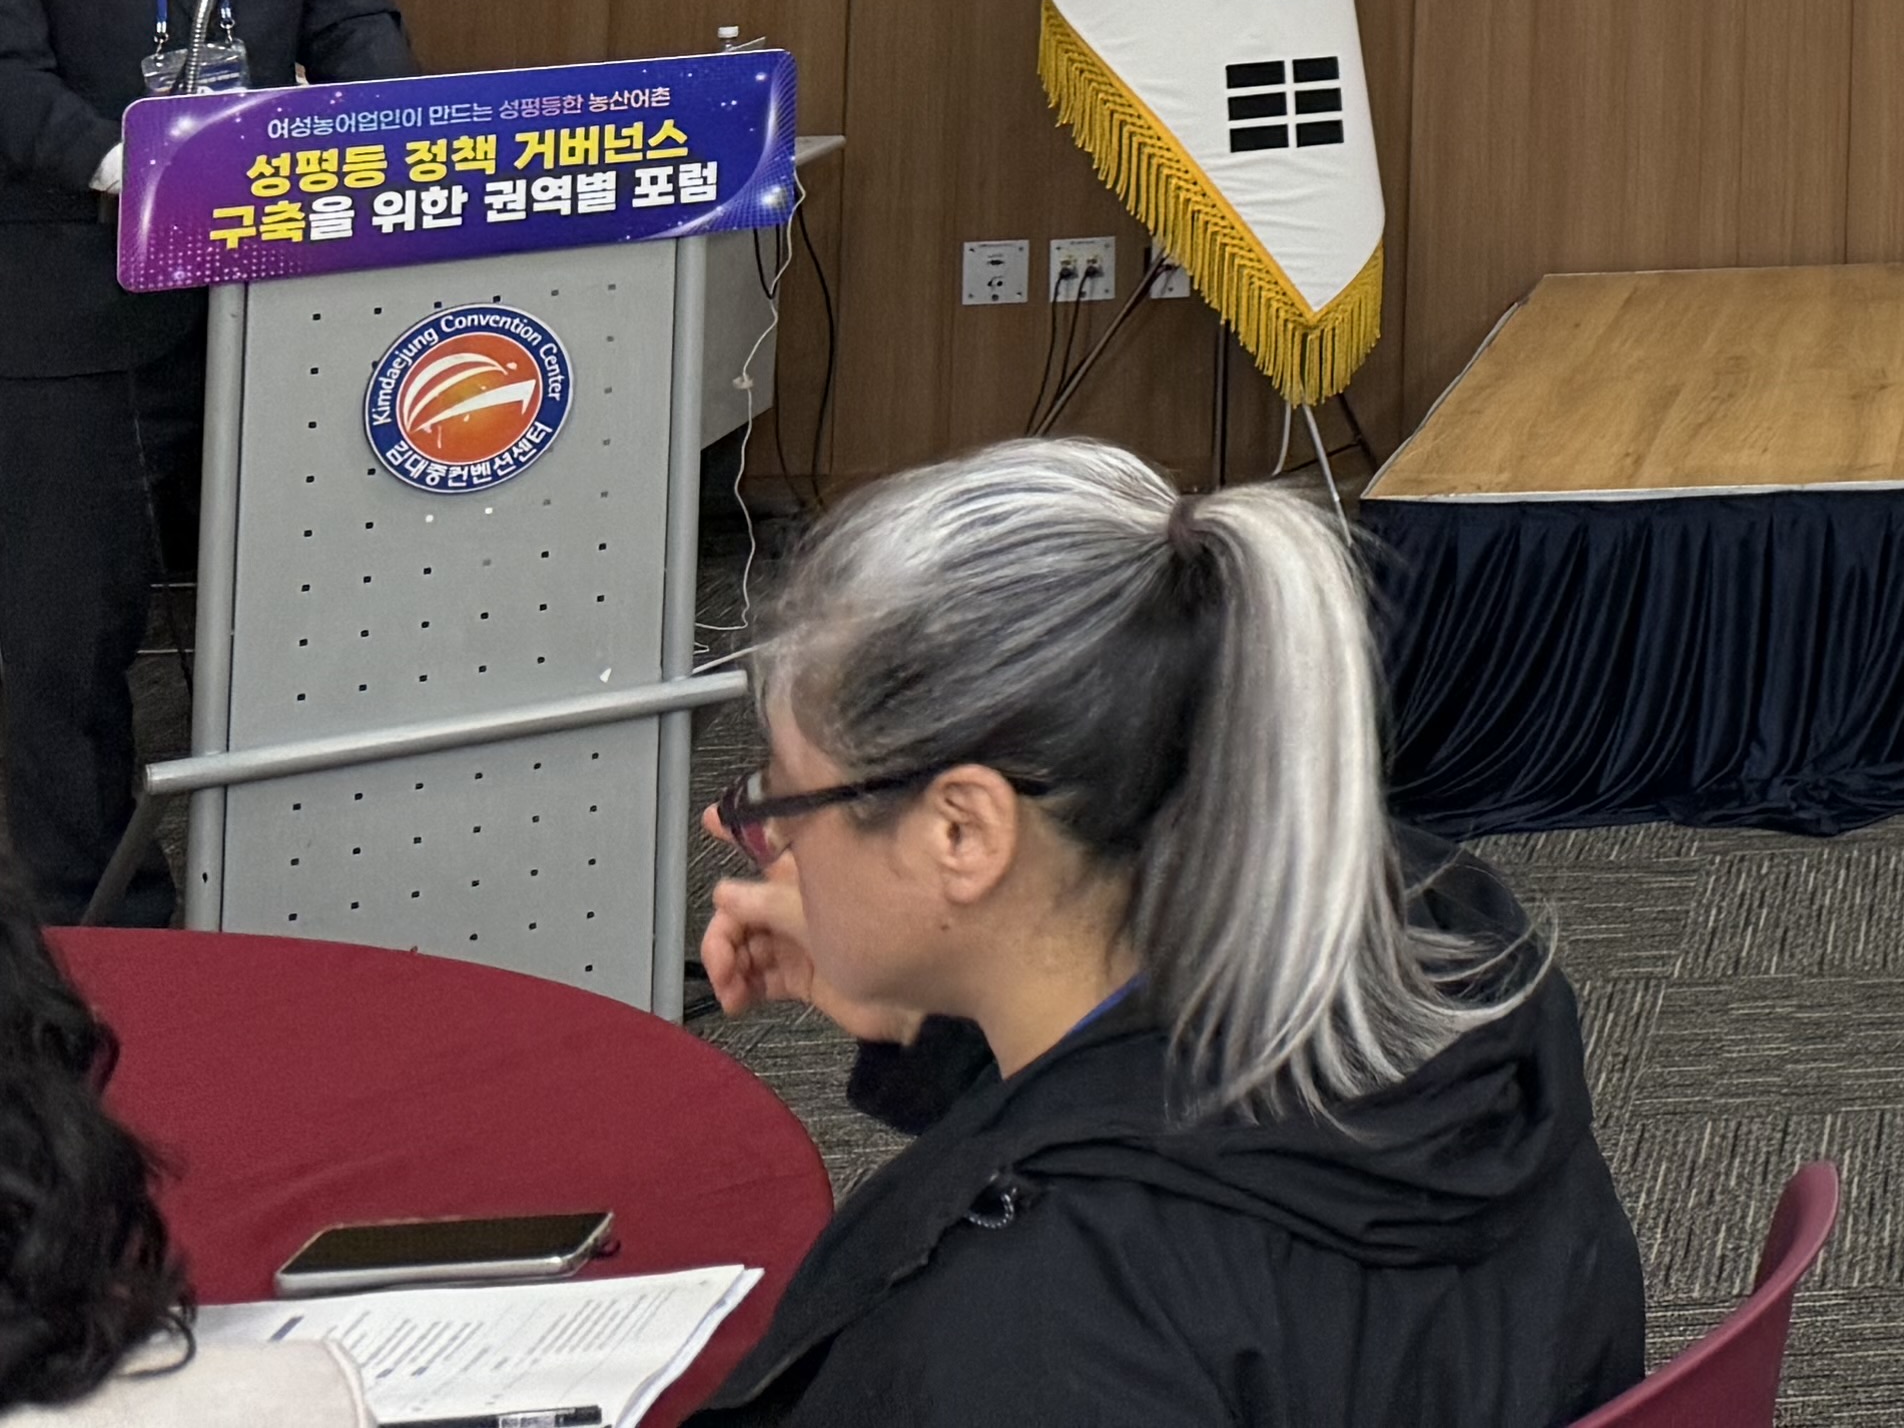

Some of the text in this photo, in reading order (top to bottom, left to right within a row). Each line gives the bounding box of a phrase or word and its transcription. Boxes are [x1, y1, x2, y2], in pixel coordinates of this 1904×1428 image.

[267, 86, 671, 140] 여성농어업인이 만드는 성평등한 농산어촌
[246, 118, 689, 198] 성평등 정책 거버넌스
[209, 161, 718, 251] 구축을 위한 권역별 포럼
[372, 313, 566, 426] Kimdaejung Convention Center
[385, 420, 553, 488] 김대중컨벤션센터
